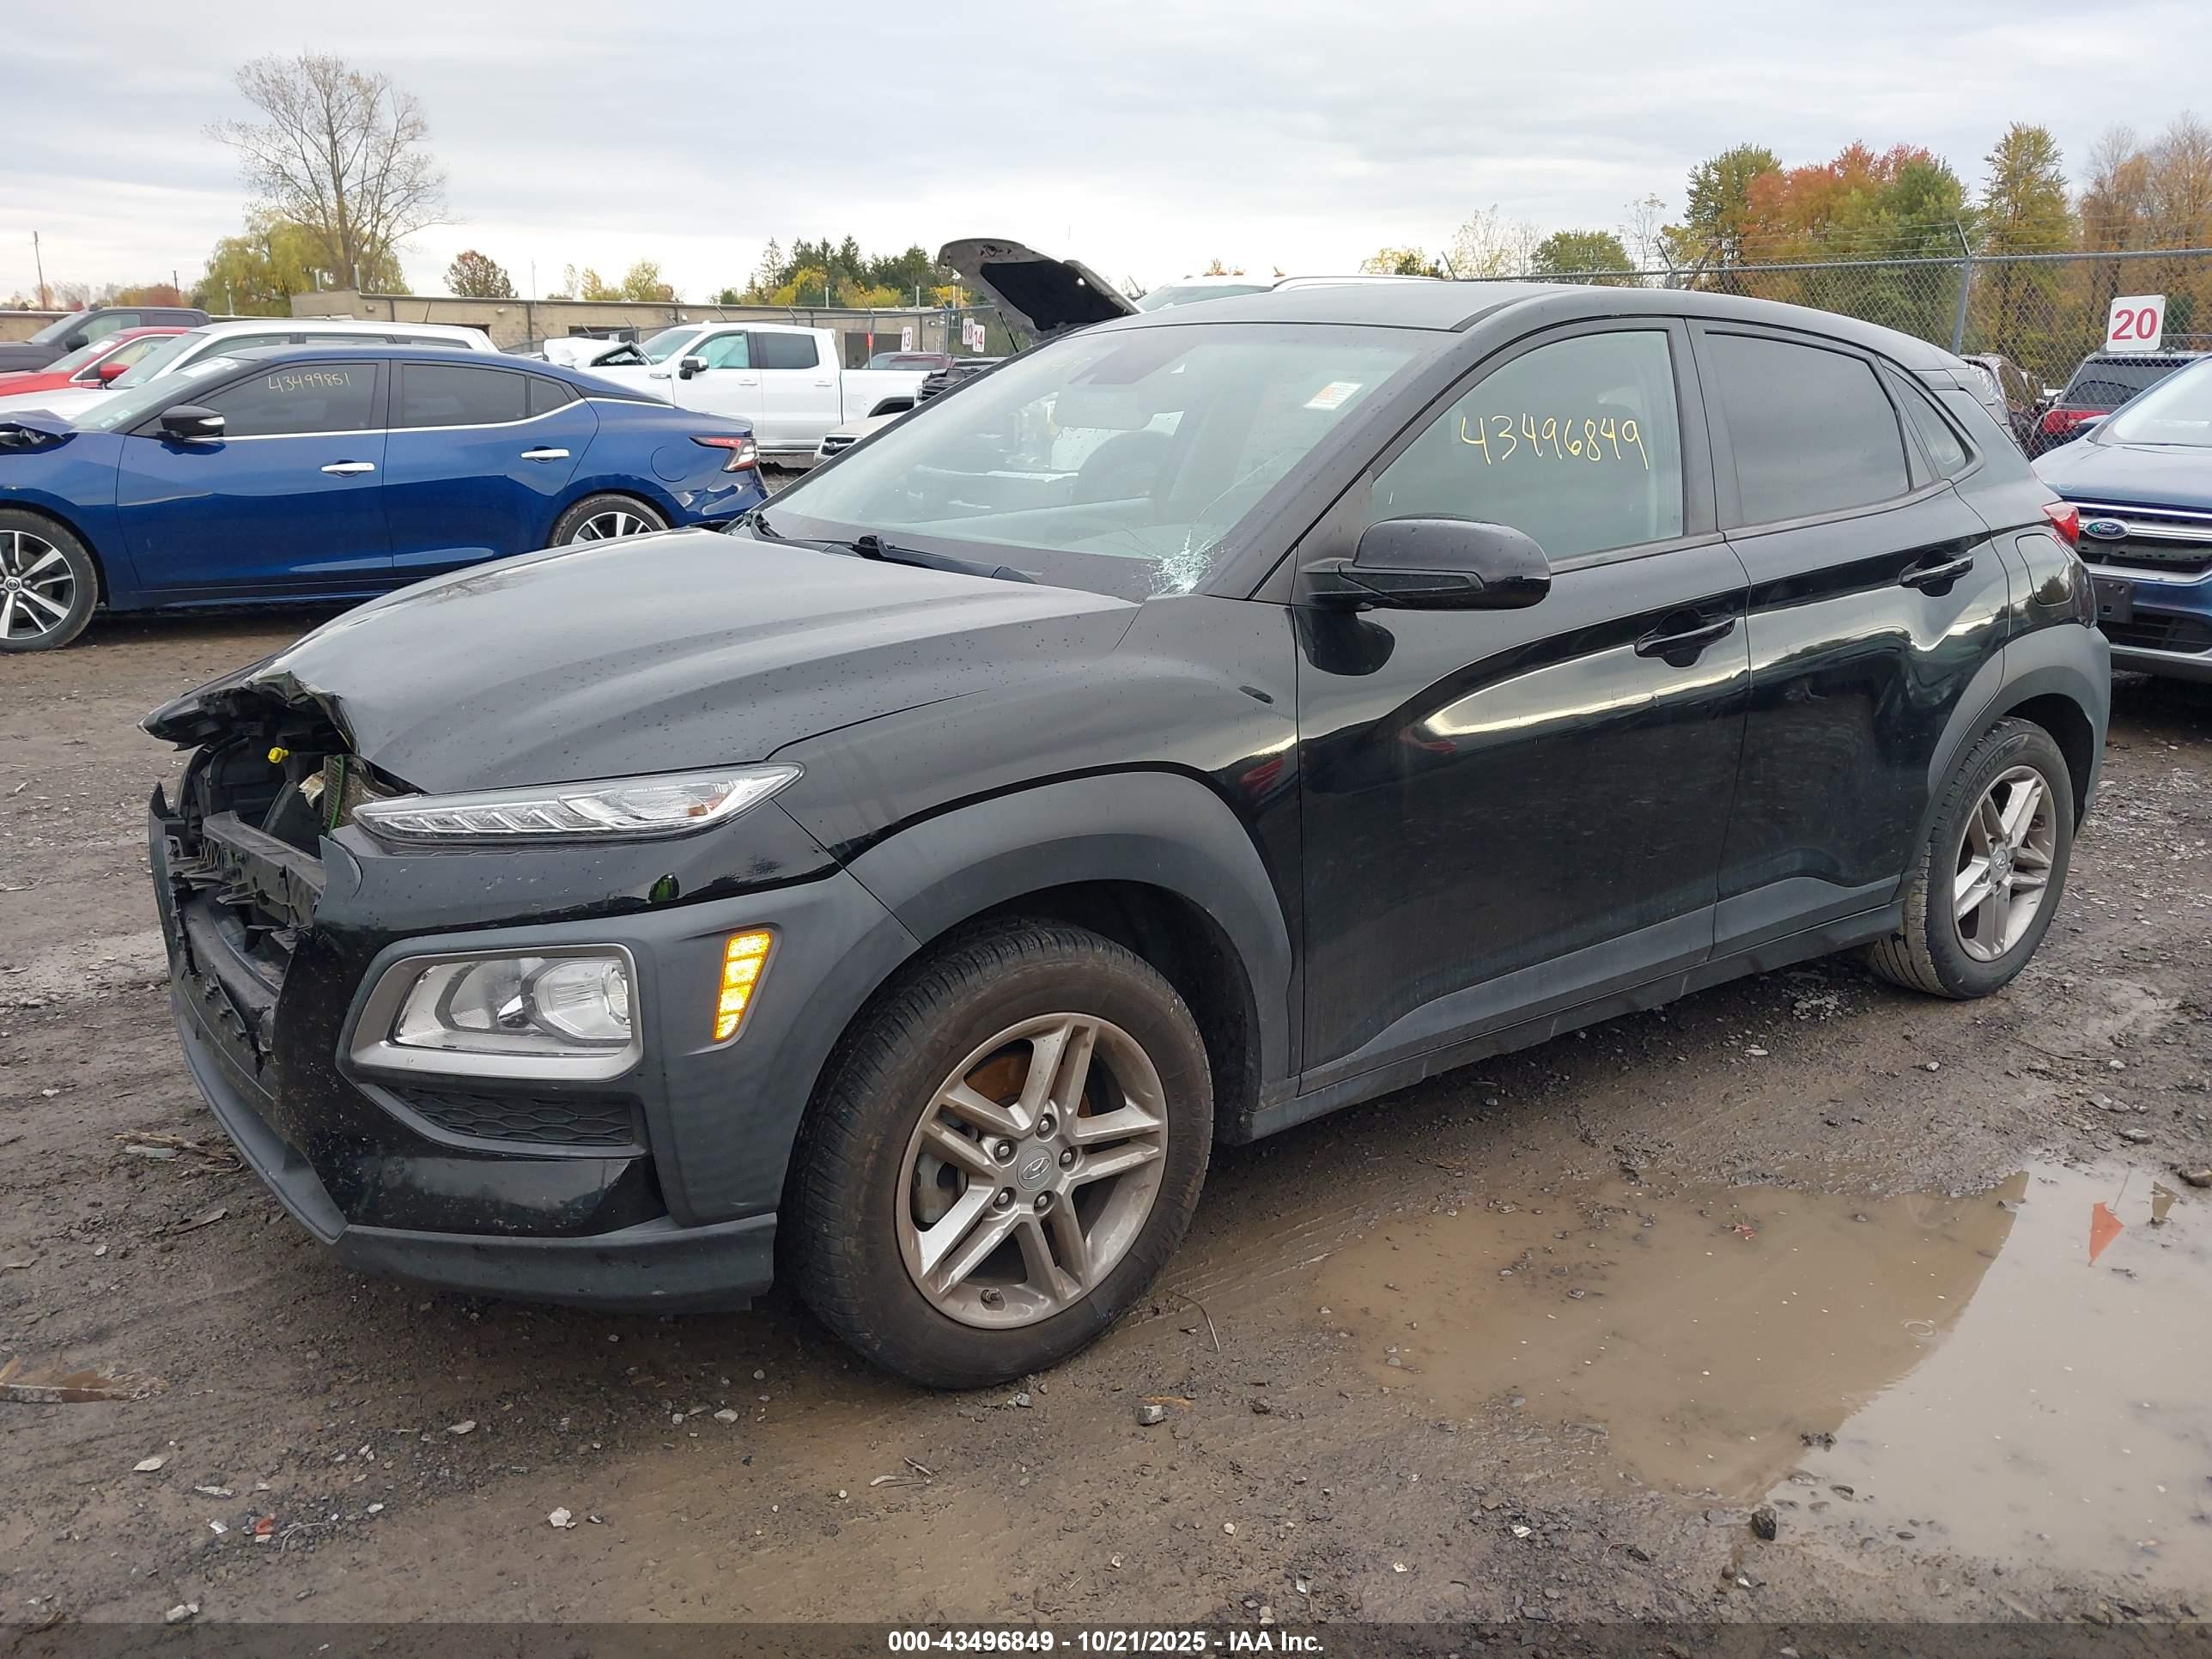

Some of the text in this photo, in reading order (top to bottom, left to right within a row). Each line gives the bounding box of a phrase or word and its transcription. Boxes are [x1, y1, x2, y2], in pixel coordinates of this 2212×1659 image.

[963, 324, 973, 340] 10
[2112, 307, 2158, 340] 20
[902, 331, 911, 348] 13
[974, 330, 983, 348] 14
[267, 372, 350, 392] 43499851
[1461, 412, 1649, 471] 43496849
